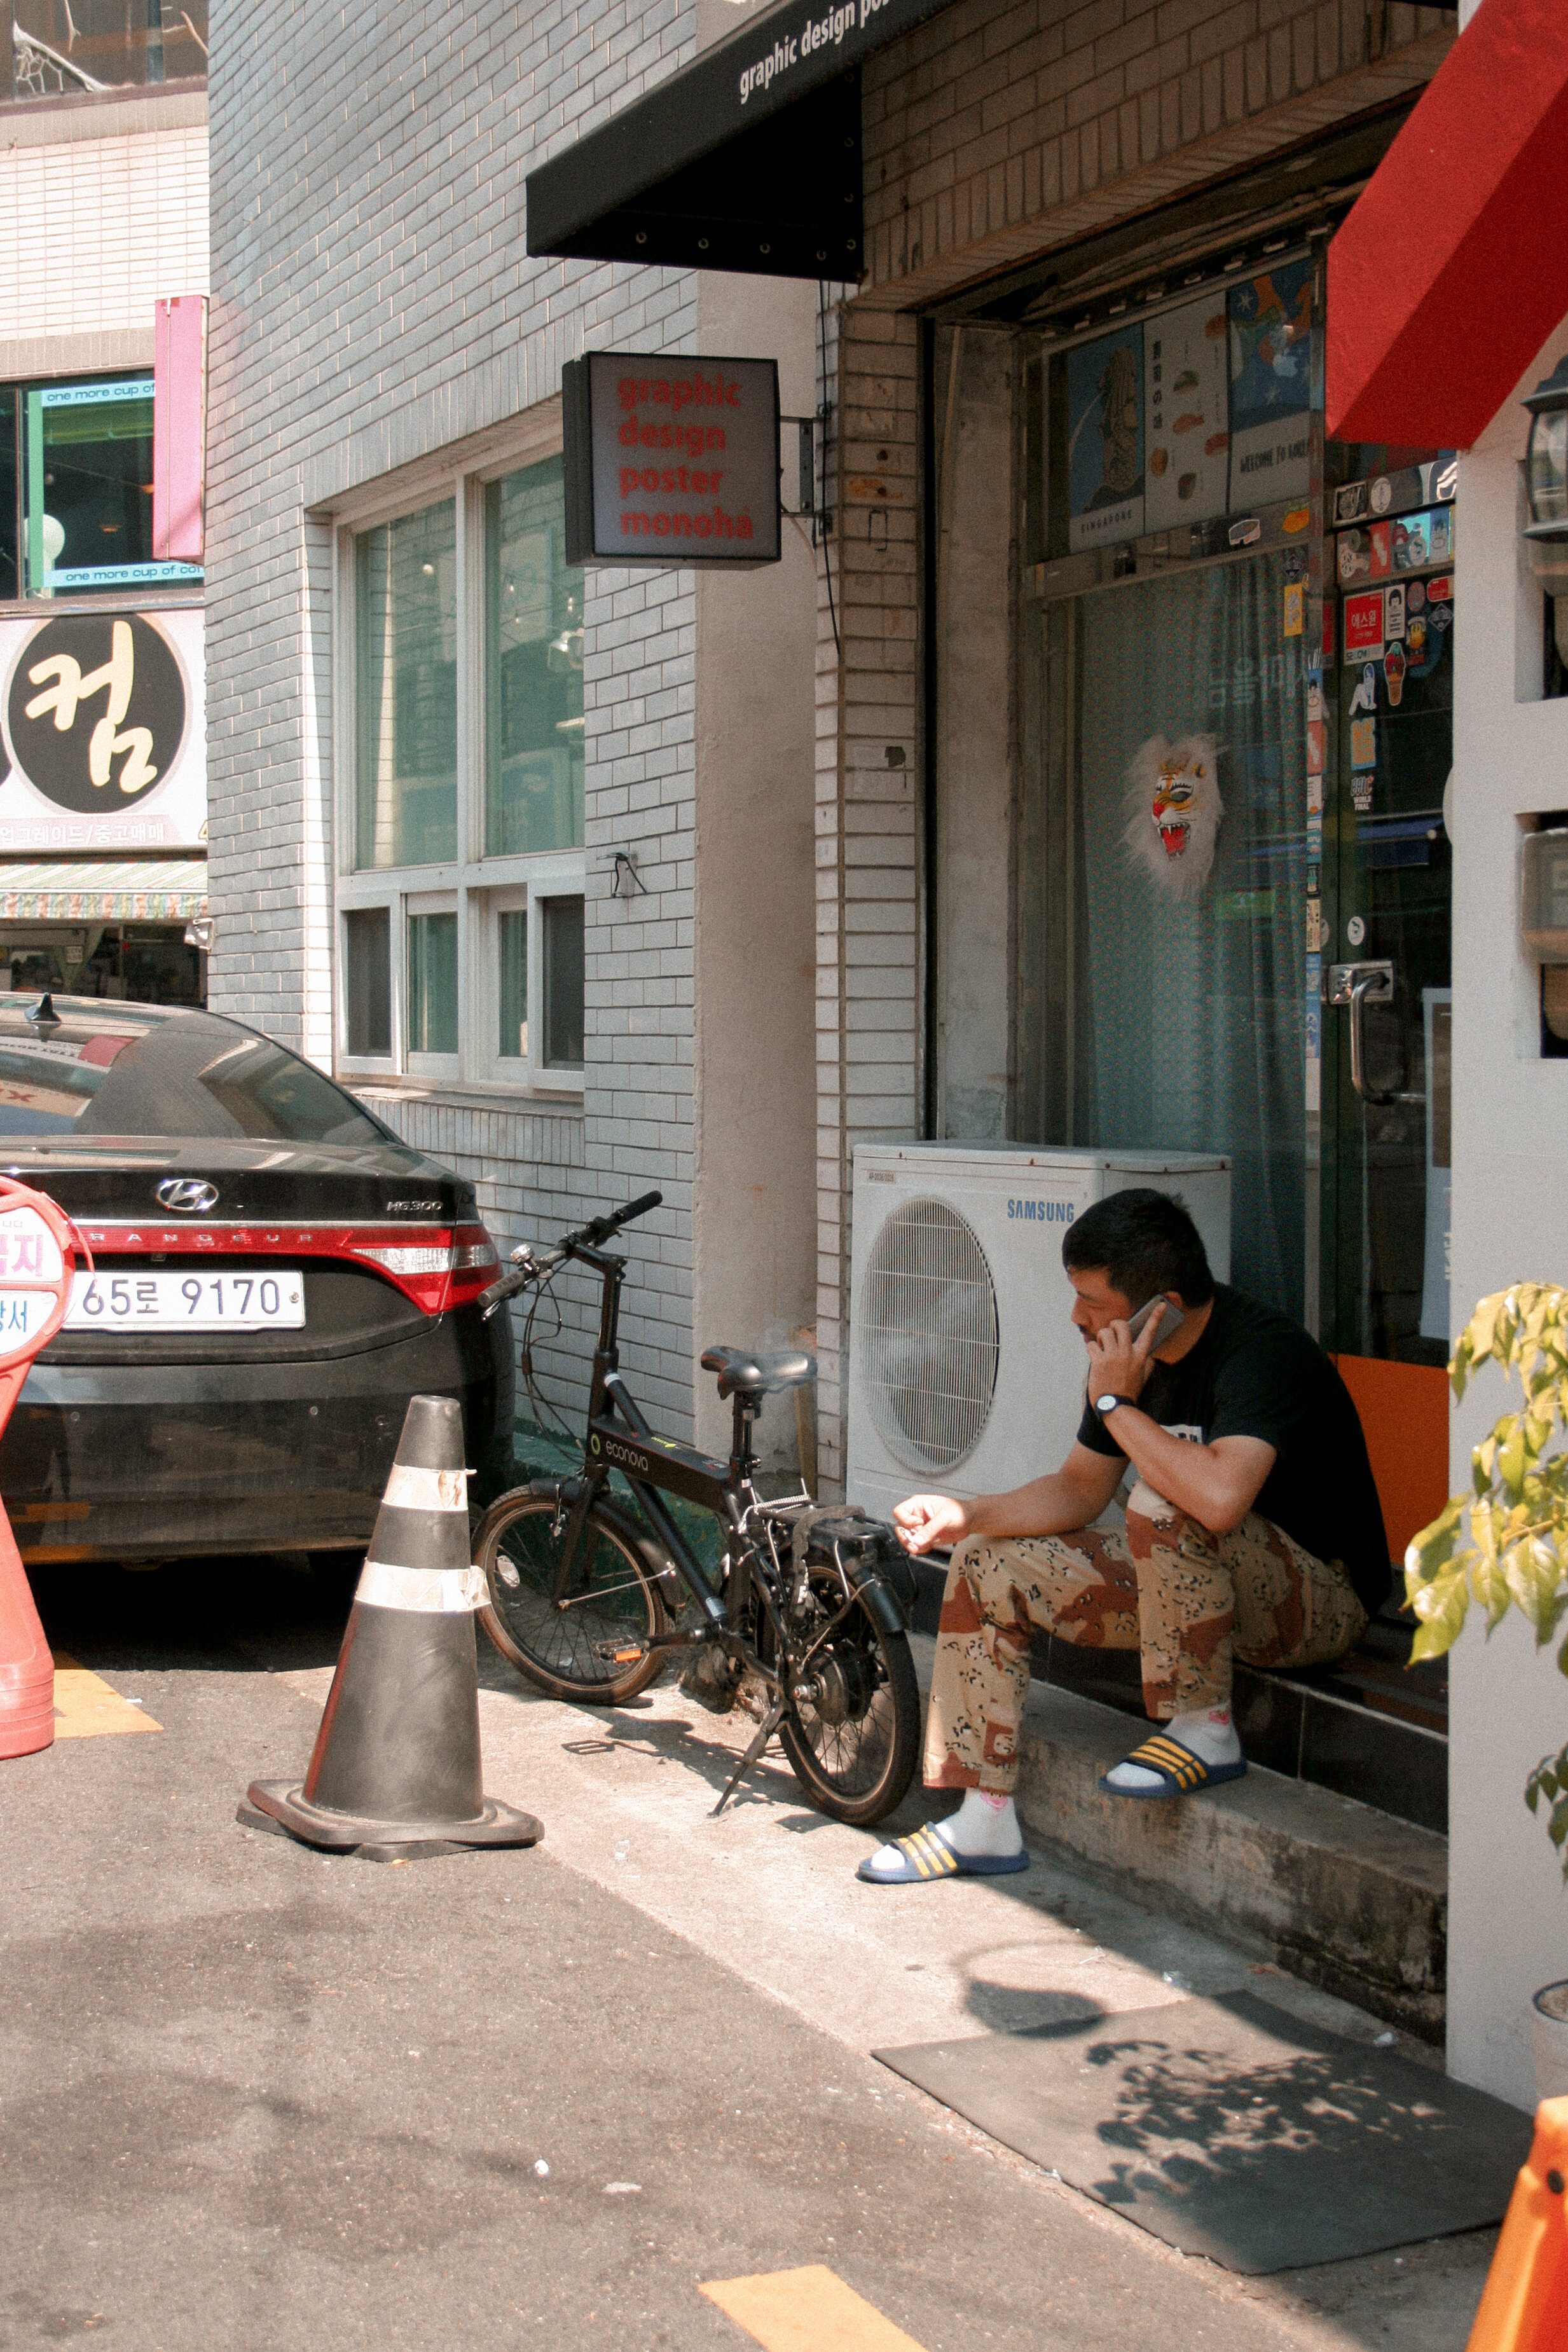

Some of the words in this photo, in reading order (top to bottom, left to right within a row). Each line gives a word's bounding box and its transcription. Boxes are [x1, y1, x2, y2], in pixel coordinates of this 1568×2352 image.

[739, 35, 797, 104] graphic
[801, 1, 855, 57] design
[47, 392, 70, 402] one
[75, 388, 109, 400] more
[114, 386, 139, 397] cup
[617, 373, 741, 411] graphic
[618, 414, 726, 458] design
[620, 465, 723, 499] poster
[1080, 509, 1132, 534] SINGAPORE
[66, 572, 90, 581] one
[94, 568, 128, 579] more
[133, 567, 157, 579] cup
[162, 565, 175, 575] of
[25, 619, 158, 794] 컴
[386, 1200, 443, 1211] HG300
[1007, 1199, 1074, 1223] SAMSUNG
[90, 1232, 313, 1242] RANDEUR
[0, 1234, 43, 1277] 지
[83, 1279, 159, 1315] 65로
[182, 1279, 280, 1314] 9170
[605, 1440, 649, 1471] econova
